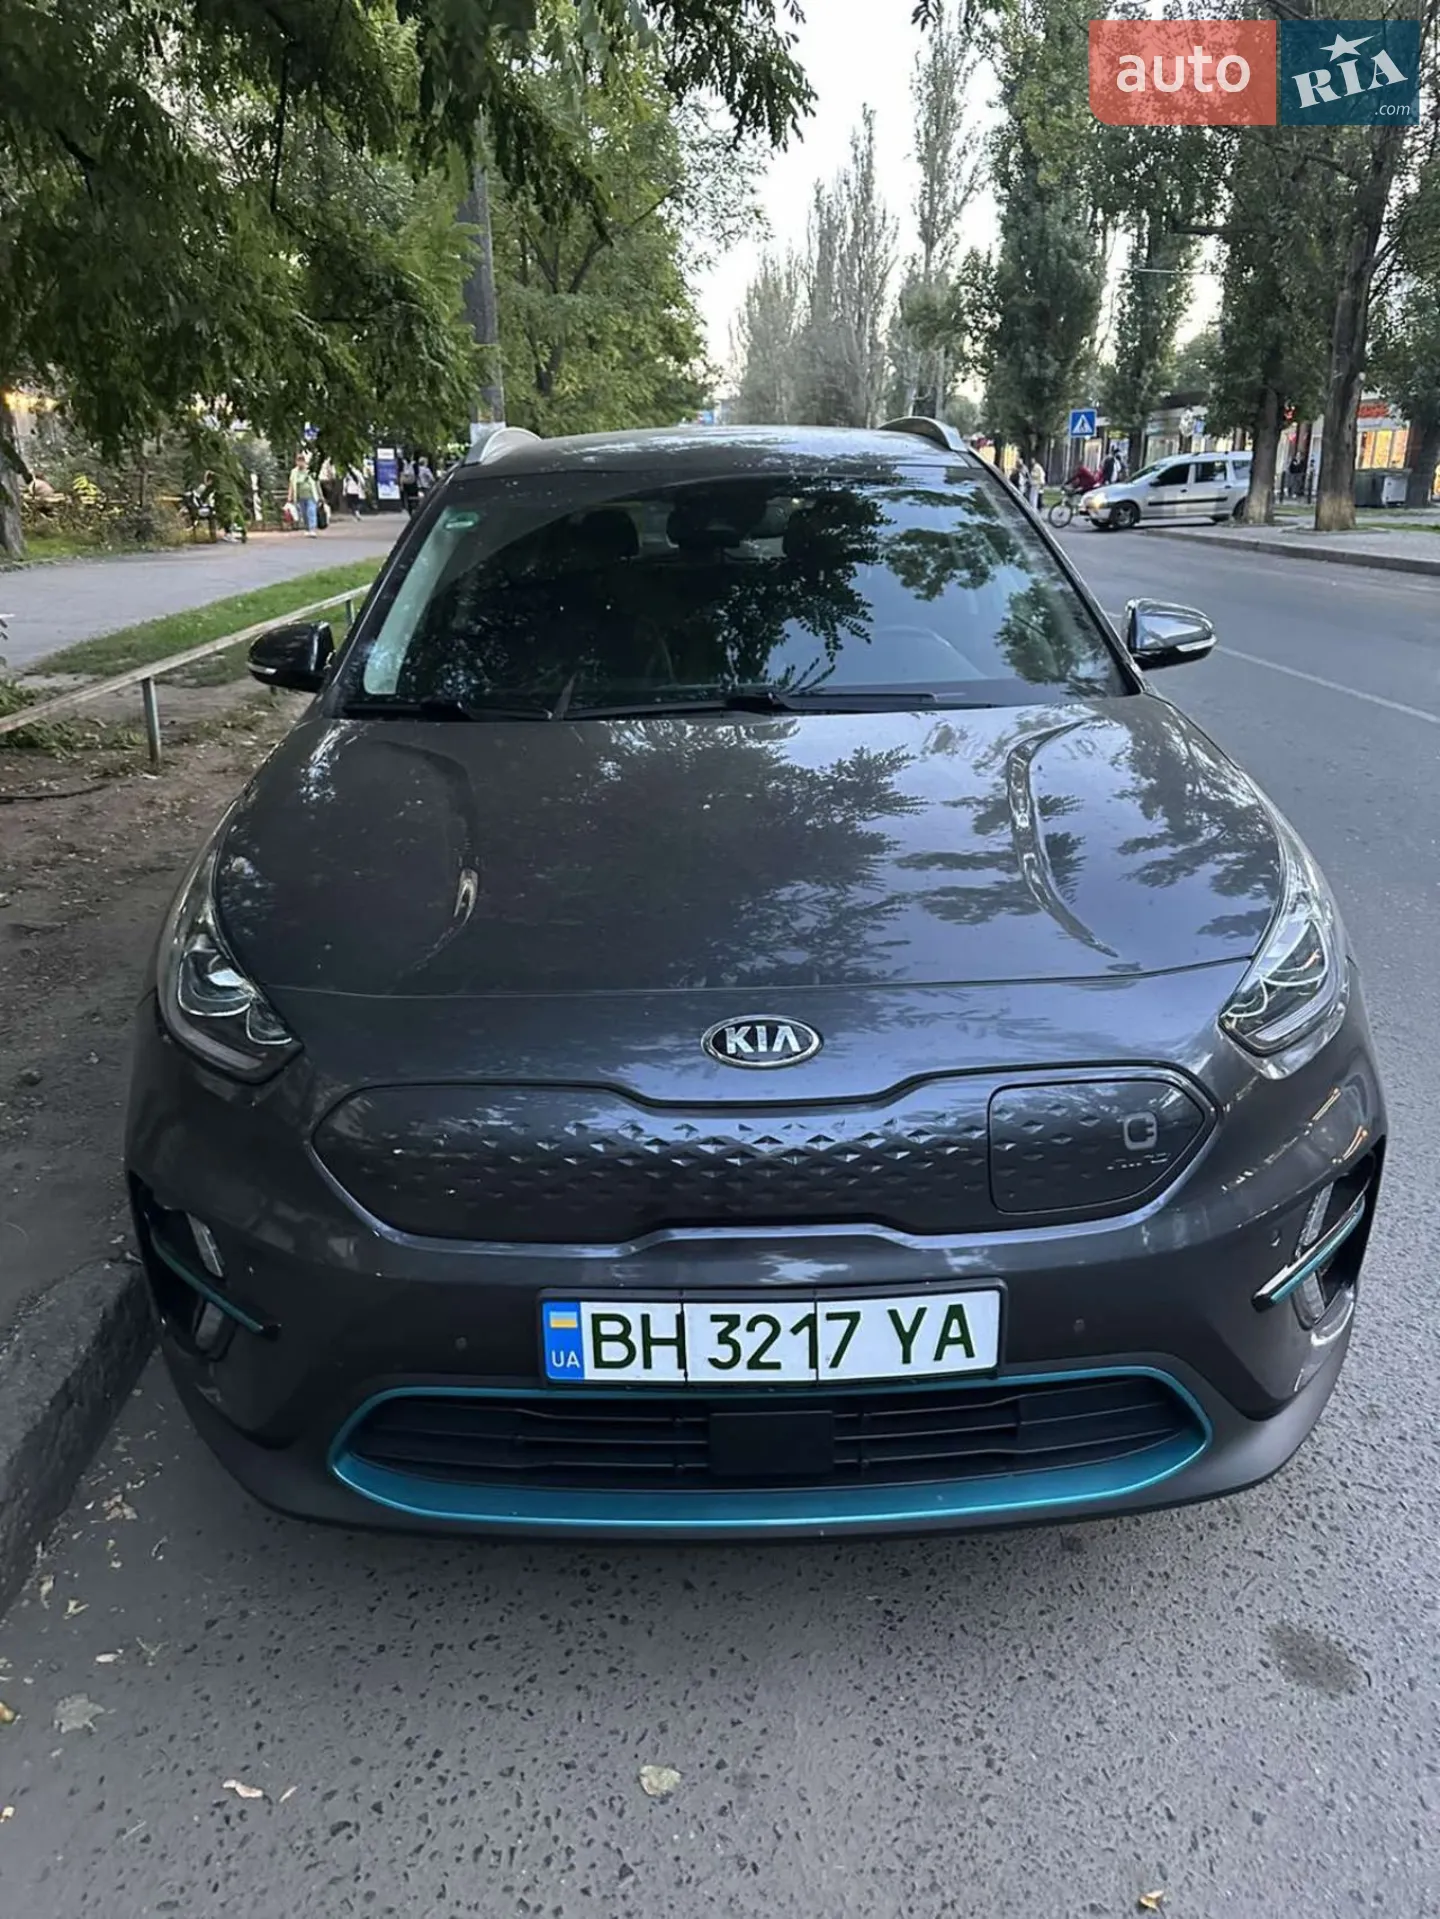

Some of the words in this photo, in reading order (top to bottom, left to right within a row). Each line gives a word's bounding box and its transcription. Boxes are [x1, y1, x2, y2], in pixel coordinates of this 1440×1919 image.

[724, 1025, 801, 1054] KIA
[591, 1313, 686, 1370] BH
[708, 1313, 861, 1370] 3217
[888, 1303, 976, 1365] YA
[551, 1349, 581, 1369] UA
